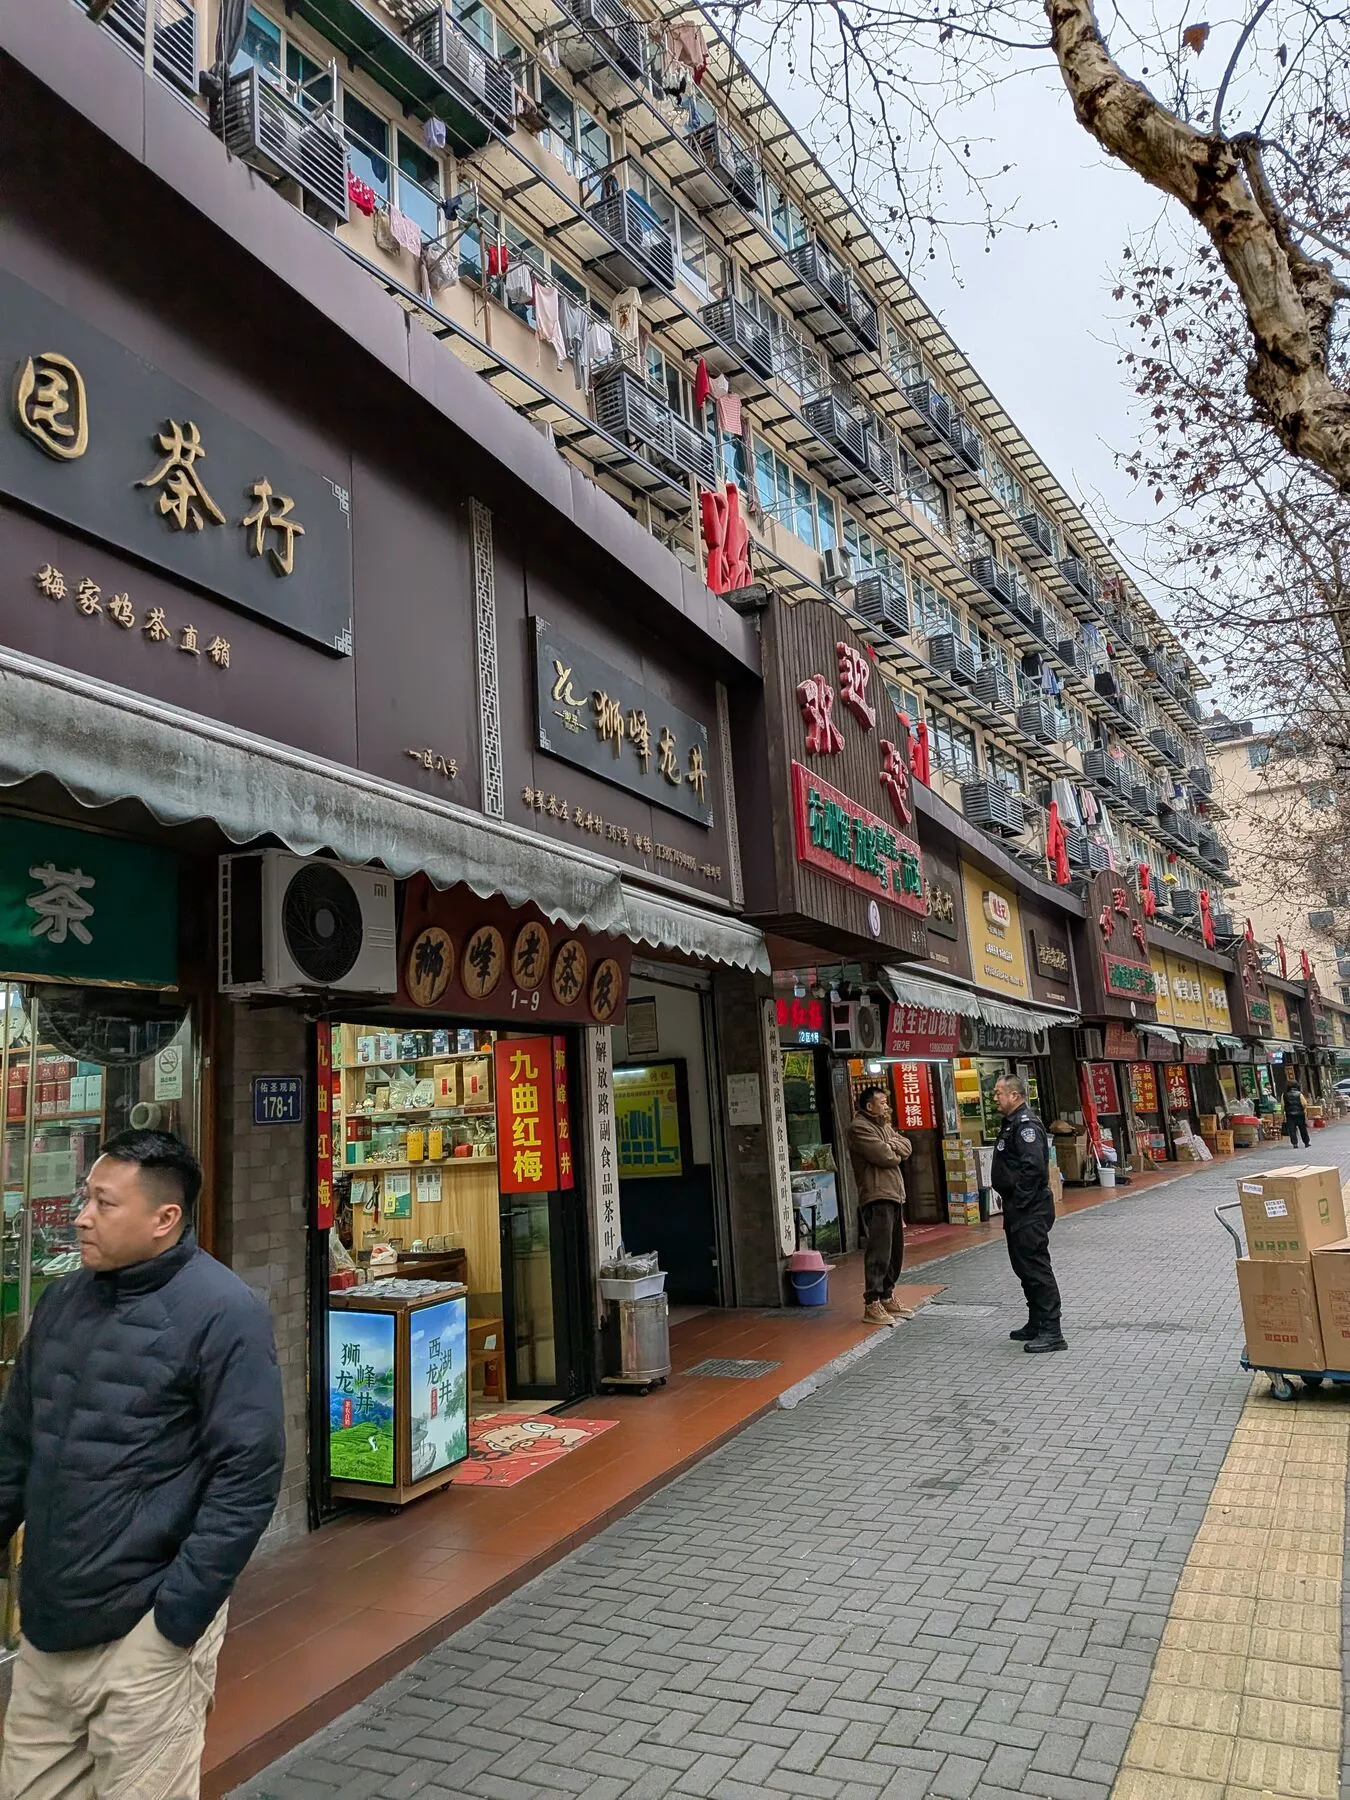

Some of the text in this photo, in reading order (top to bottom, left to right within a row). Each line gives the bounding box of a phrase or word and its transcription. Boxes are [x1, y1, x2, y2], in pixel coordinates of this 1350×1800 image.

[37, 563, 231, 668] 梅家坞茶直销
[27, 861, 95, 944] 茶
[511, 990, 540, 1011] 1-9
[263, 1096, 293, 1119] 178-1
[509, 1050, 543, 1183] 九曲红梅
[555, 1050, 571, 1175] 狮峰龙井
[901, 1062, 923, 1127] 姚生记山核桃
[1170, 1076, 1188, 1107] 小核桃
